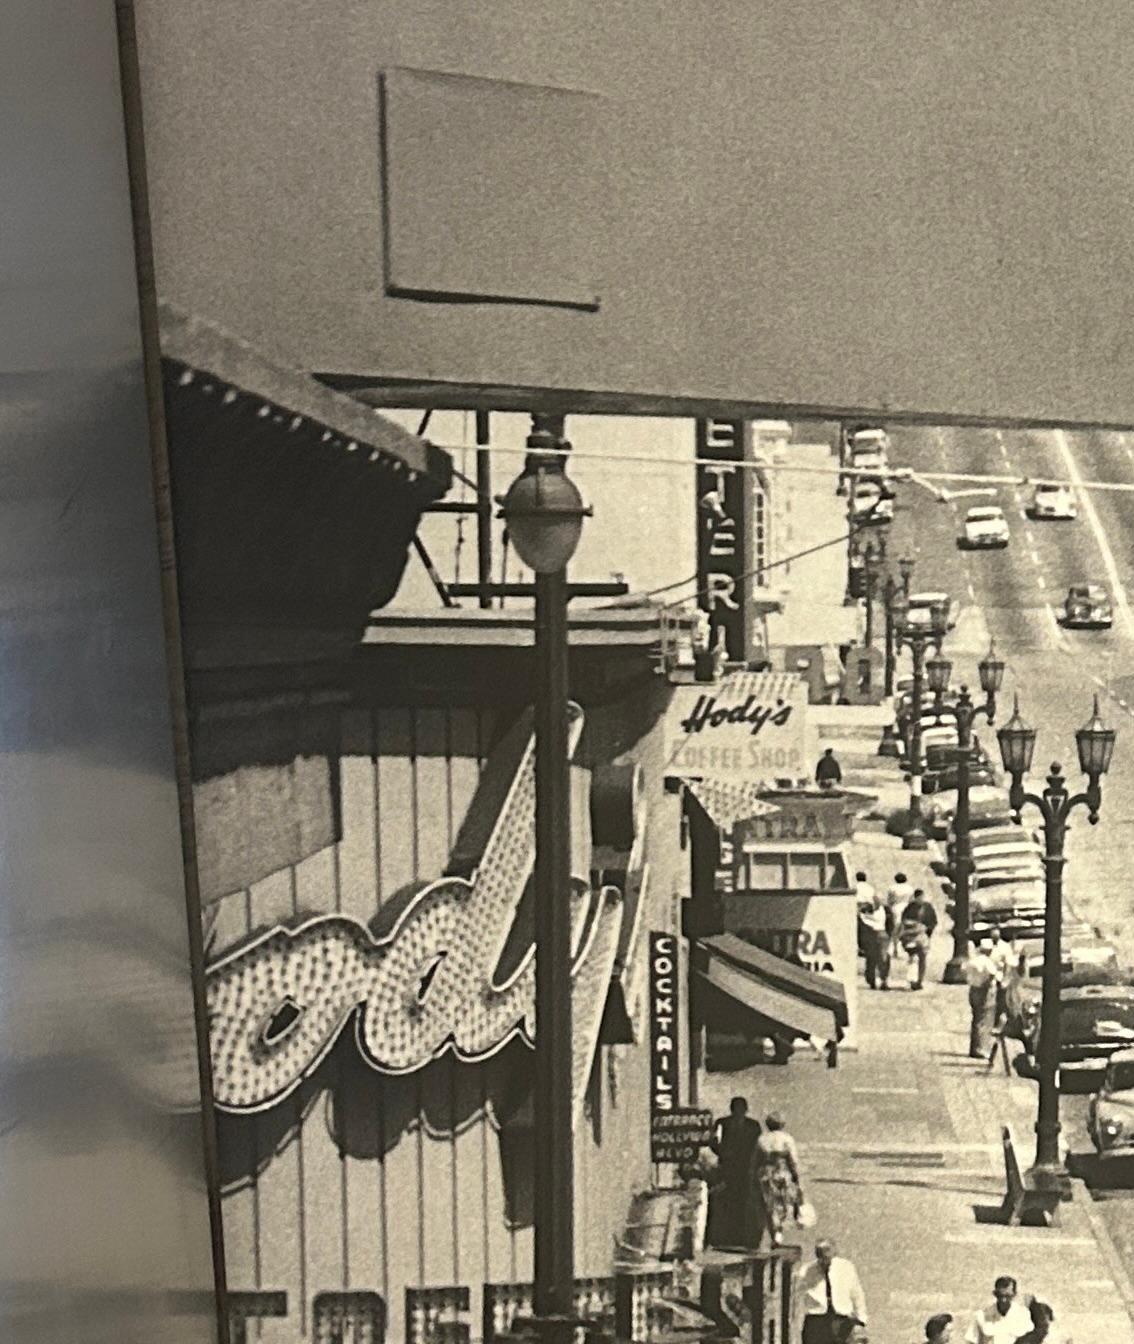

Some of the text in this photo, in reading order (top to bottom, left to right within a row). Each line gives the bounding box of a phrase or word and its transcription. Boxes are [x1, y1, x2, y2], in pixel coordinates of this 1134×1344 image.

[681, 694, 794, 735] Hody's
[673, 739, 801, 770] COFFEE SHOP
[654, 937, 674, 1111] COCKTAILS
